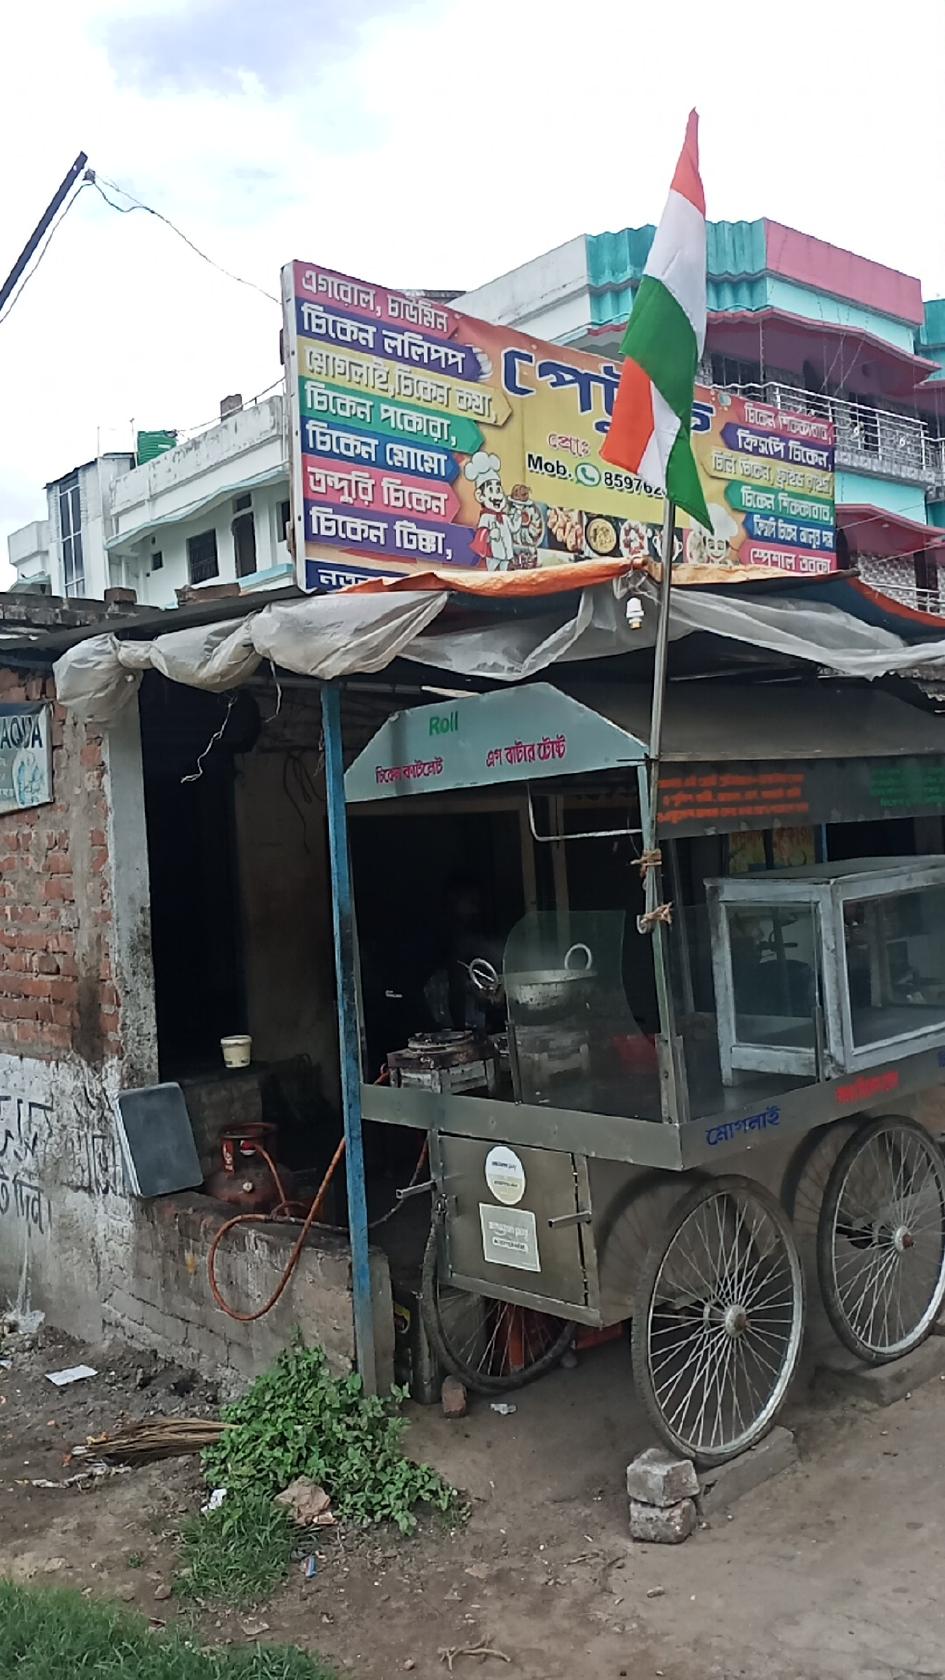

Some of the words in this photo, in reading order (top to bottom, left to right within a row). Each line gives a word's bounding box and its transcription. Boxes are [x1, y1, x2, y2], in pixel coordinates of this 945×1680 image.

[302, 270, 381, 317] এগরোল,
[387, 293, 448, 332] চাউমিন
[301, 302, 376, 348] চিকেন
[382, 328, 465, 374] ললিপপ
[396, 367, 451, 407] চিকেন
[305, 380, 374, 422] চিকেন
[380, 403, 457, 446] পকোরা,
[744, 402, 776, 428] চিকেন
[306, 420, 379, 461] চিকেন
[385, 442, 448, 477] মোমো
[788, 440, 832, 471] চিকেন,
[527, 453, 573, 479] Mob.
[307, 466, 376, 505] তন্দুরি
[381, 477, 448, 516] চিকেন
[740, 485, 775, 510] চিকেন
[310, 506, 388, 545] চিকেন
[394, 520, 452, 560] টিক্কা,
[750, 548, 797, 570] স্পেশাল
[0, 716, 43, 749] AQUA
[429, 711, 458, 736] Roll
[504, 740, 536, 765] বাটার
